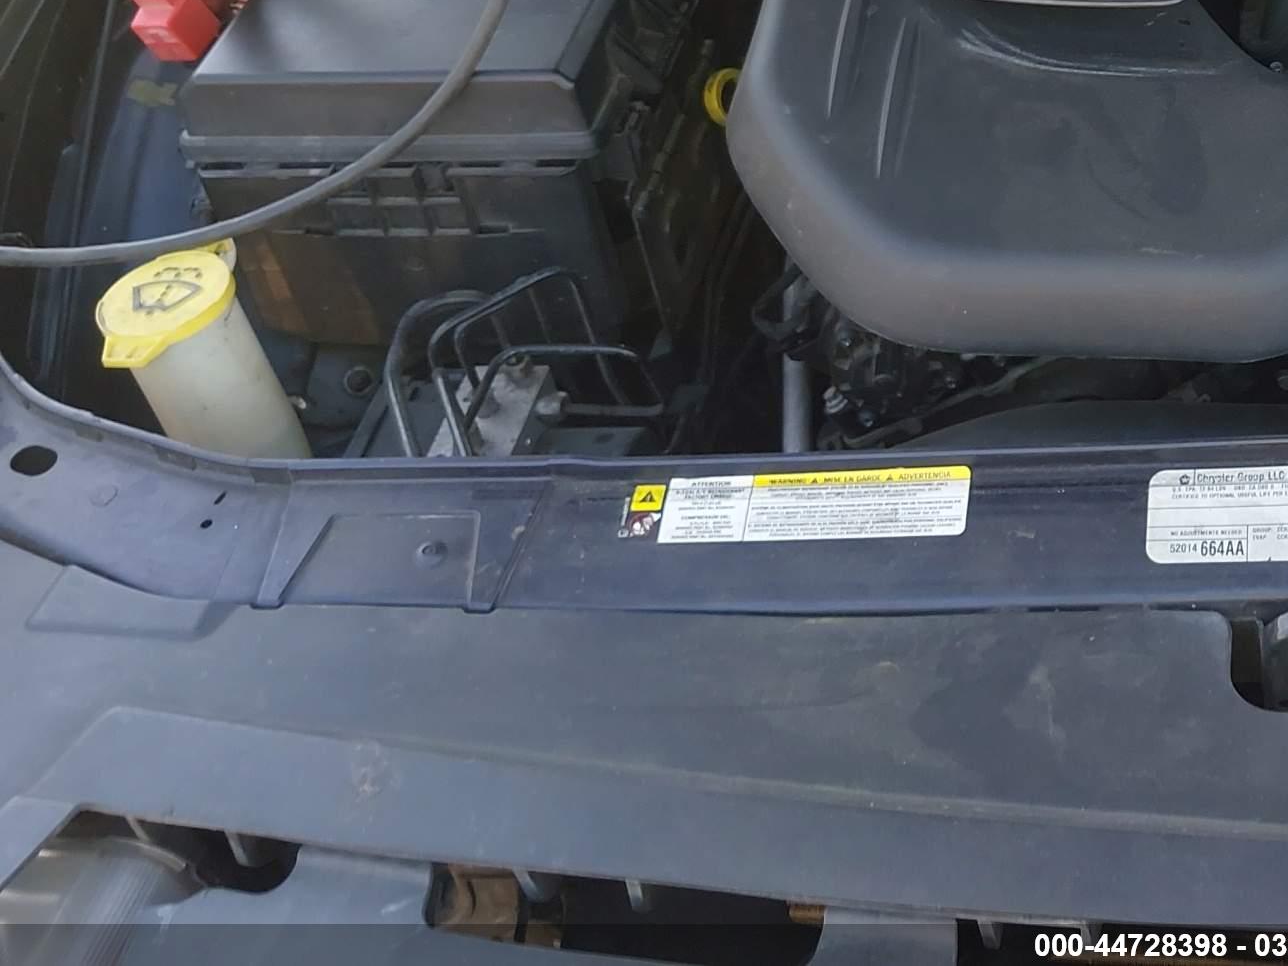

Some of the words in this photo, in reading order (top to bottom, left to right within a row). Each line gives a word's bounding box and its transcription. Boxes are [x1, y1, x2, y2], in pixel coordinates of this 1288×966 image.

[898, 470, 951, 480] ADVERTENCIA
[1196, 473, 1234, 485] Chrysler
[1237, 472, 1265, 483] Group
[1268, 470, 1285, 480] LLC
[1200, 540, 1245, 556] 664AA
